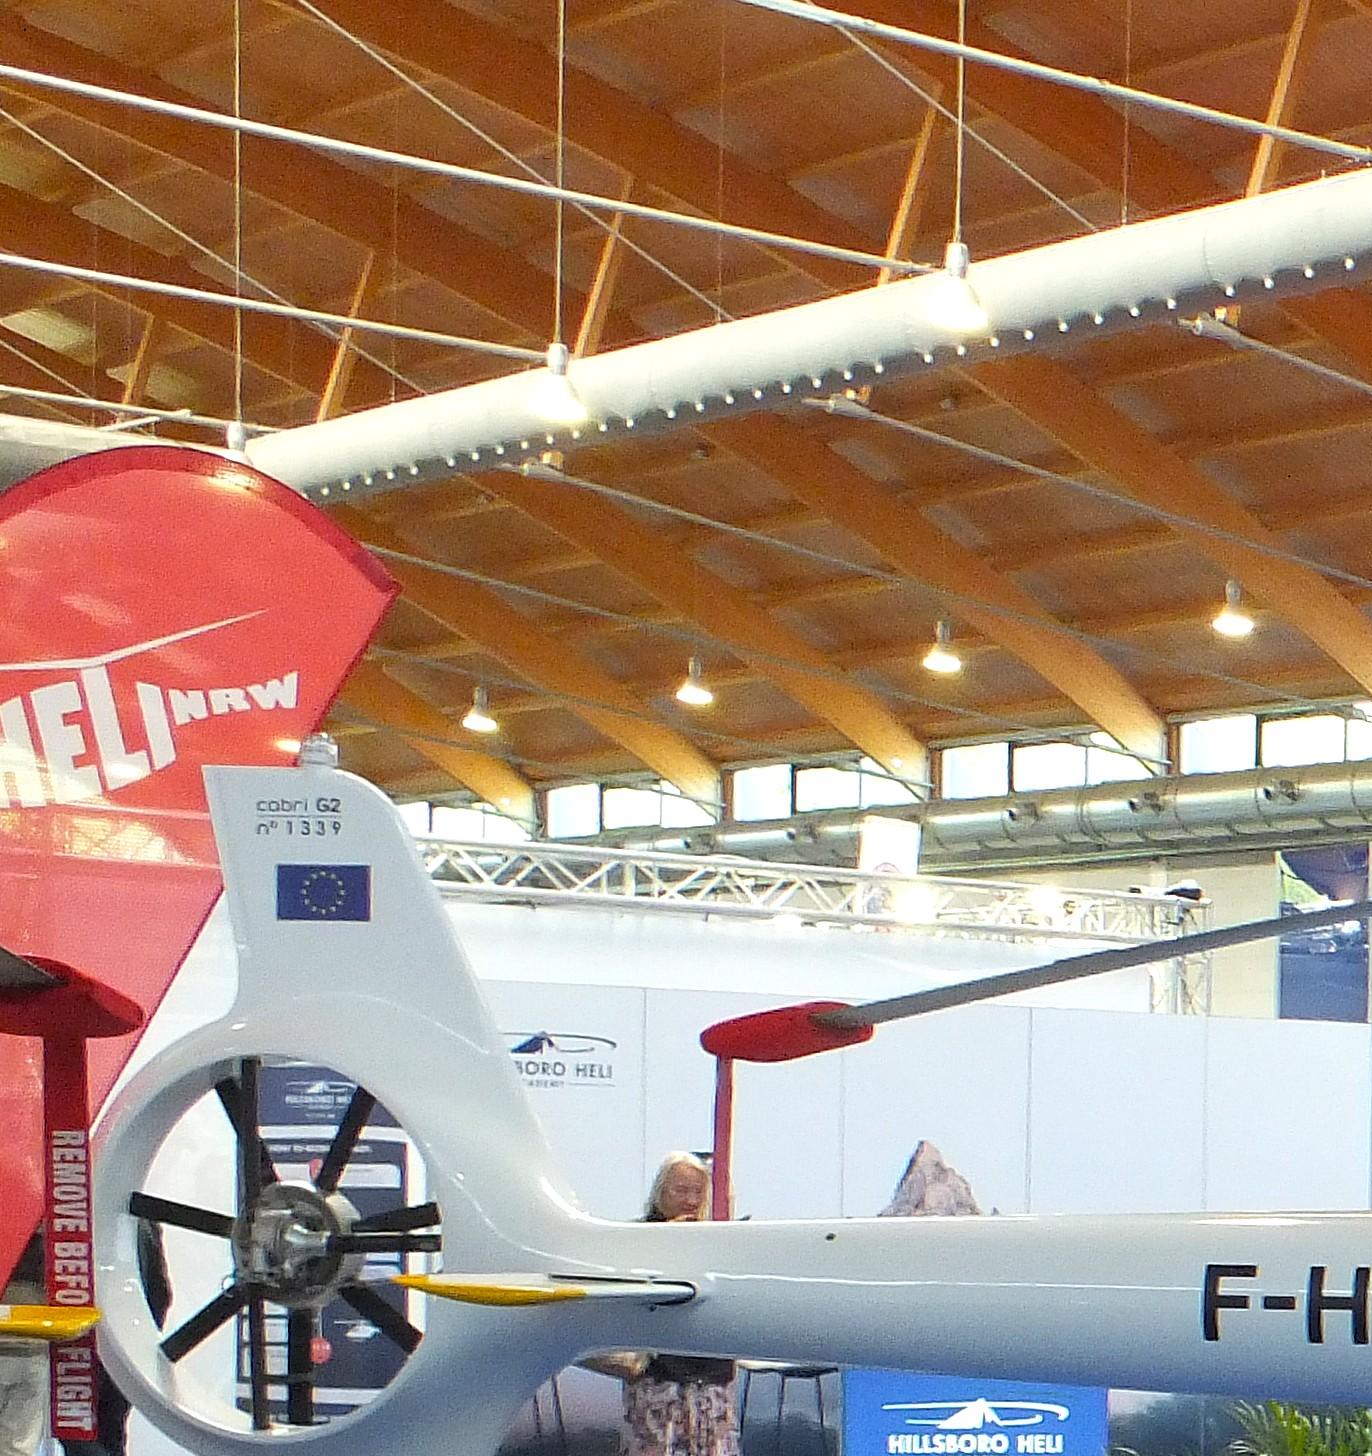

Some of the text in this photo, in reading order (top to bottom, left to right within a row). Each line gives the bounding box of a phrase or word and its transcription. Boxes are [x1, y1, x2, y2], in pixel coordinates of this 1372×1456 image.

[0, 663, 299, 808] HELI NRW
[316, 797, 341, 813] G2
[575, 1062, 614, 1079] HELI
[52, 1130, 94, 1431] REMOVE BEFO FLIGHT
[887, 1434, 1064, 1454] HILLSBORO HELI
